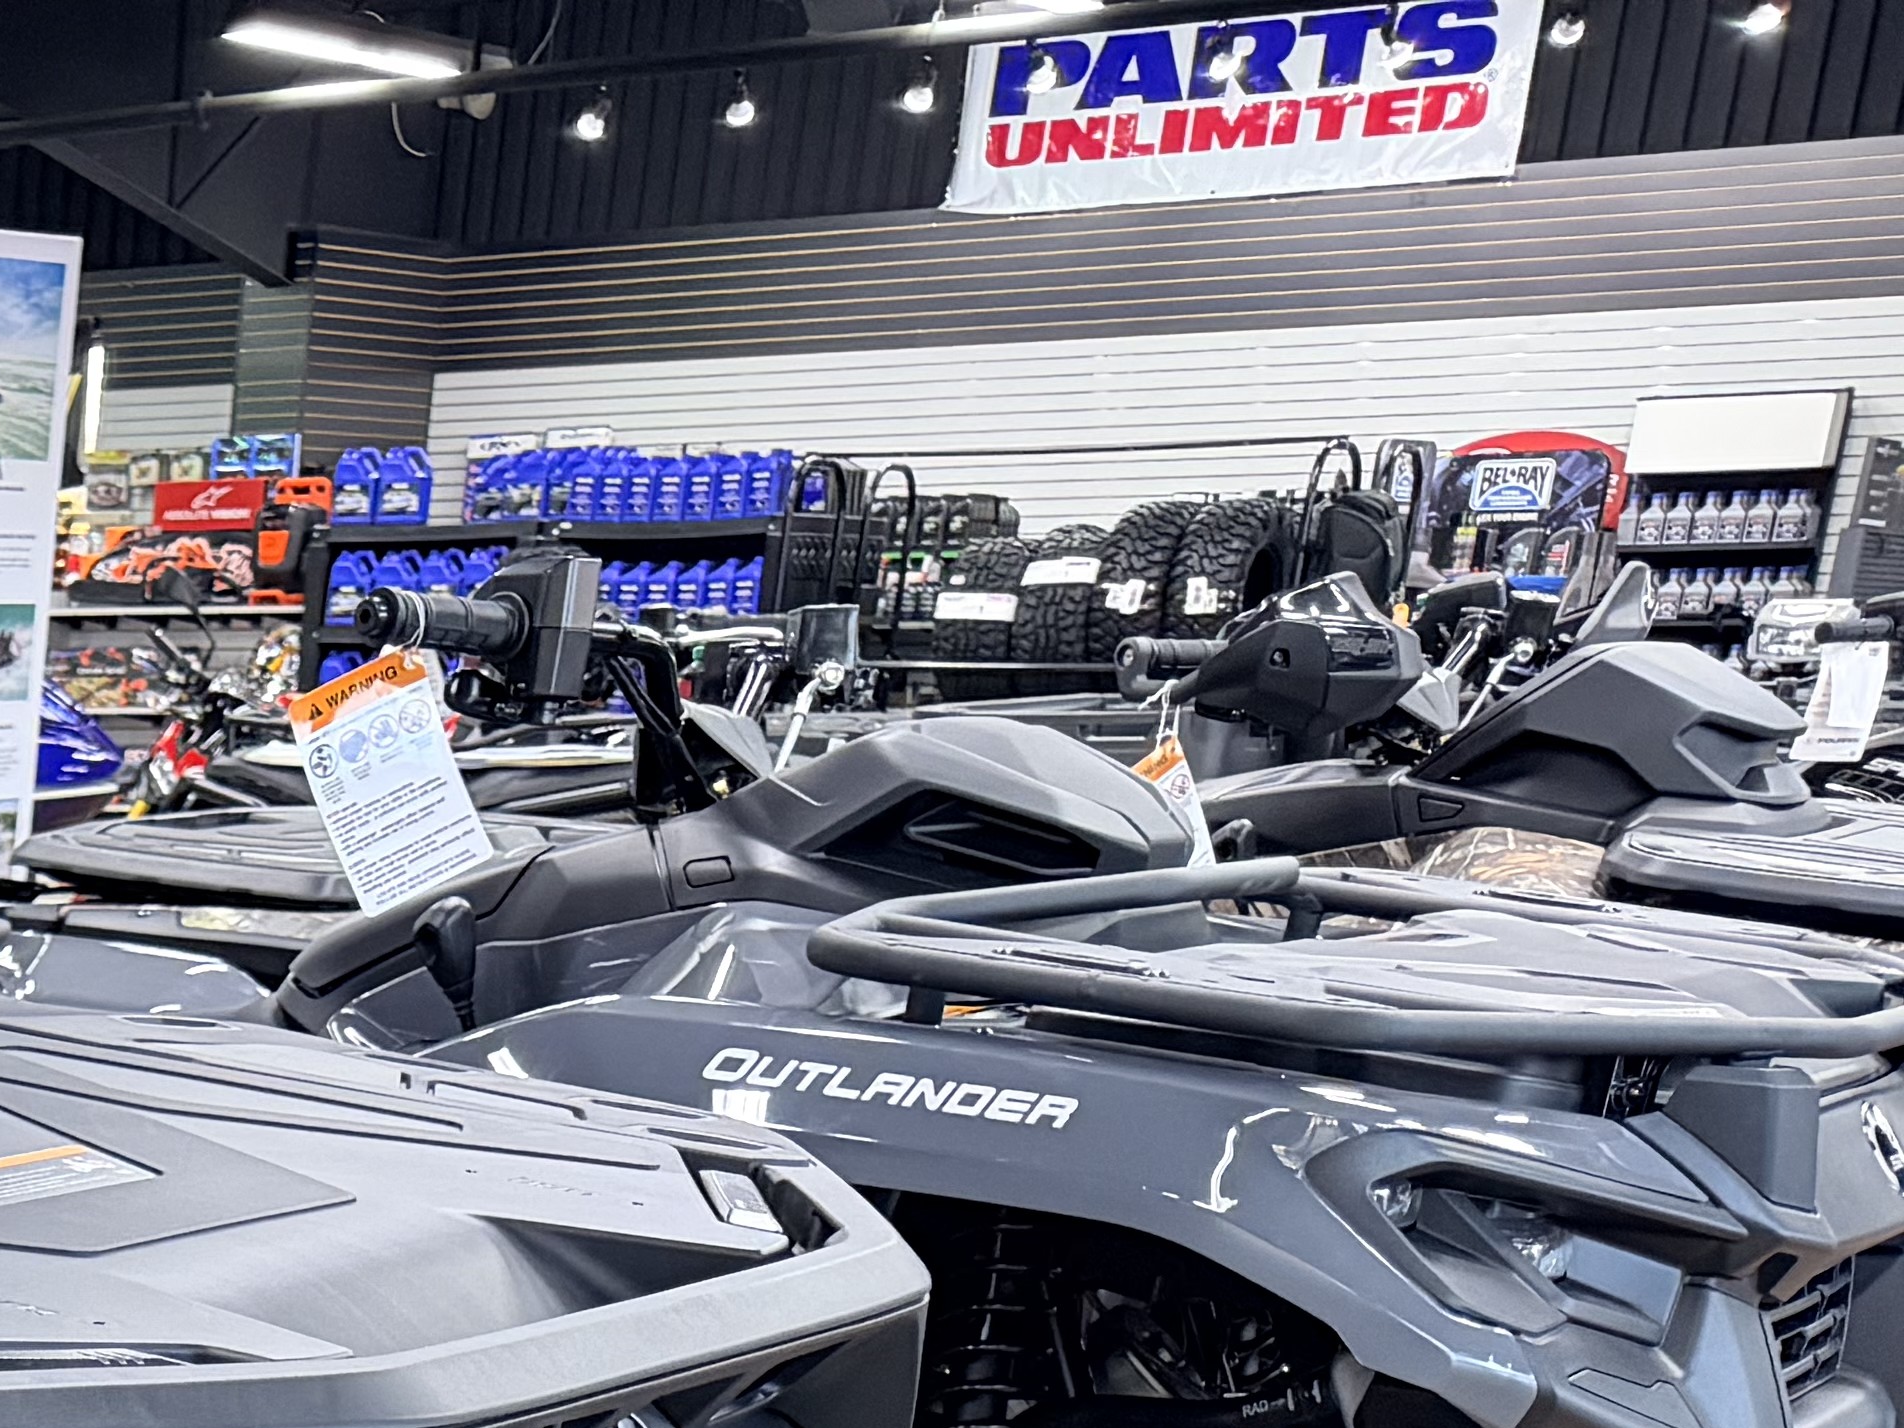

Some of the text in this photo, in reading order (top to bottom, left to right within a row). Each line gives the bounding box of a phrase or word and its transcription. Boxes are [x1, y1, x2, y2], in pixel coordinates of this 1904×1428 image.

[988, 0, 1500, 118] PARTS
[984, 81, 1489, 169] UNLIMITED
[325, 666, 398, 710] WARNING
[702, 1047, 1079, 1129] OUTLANDER
